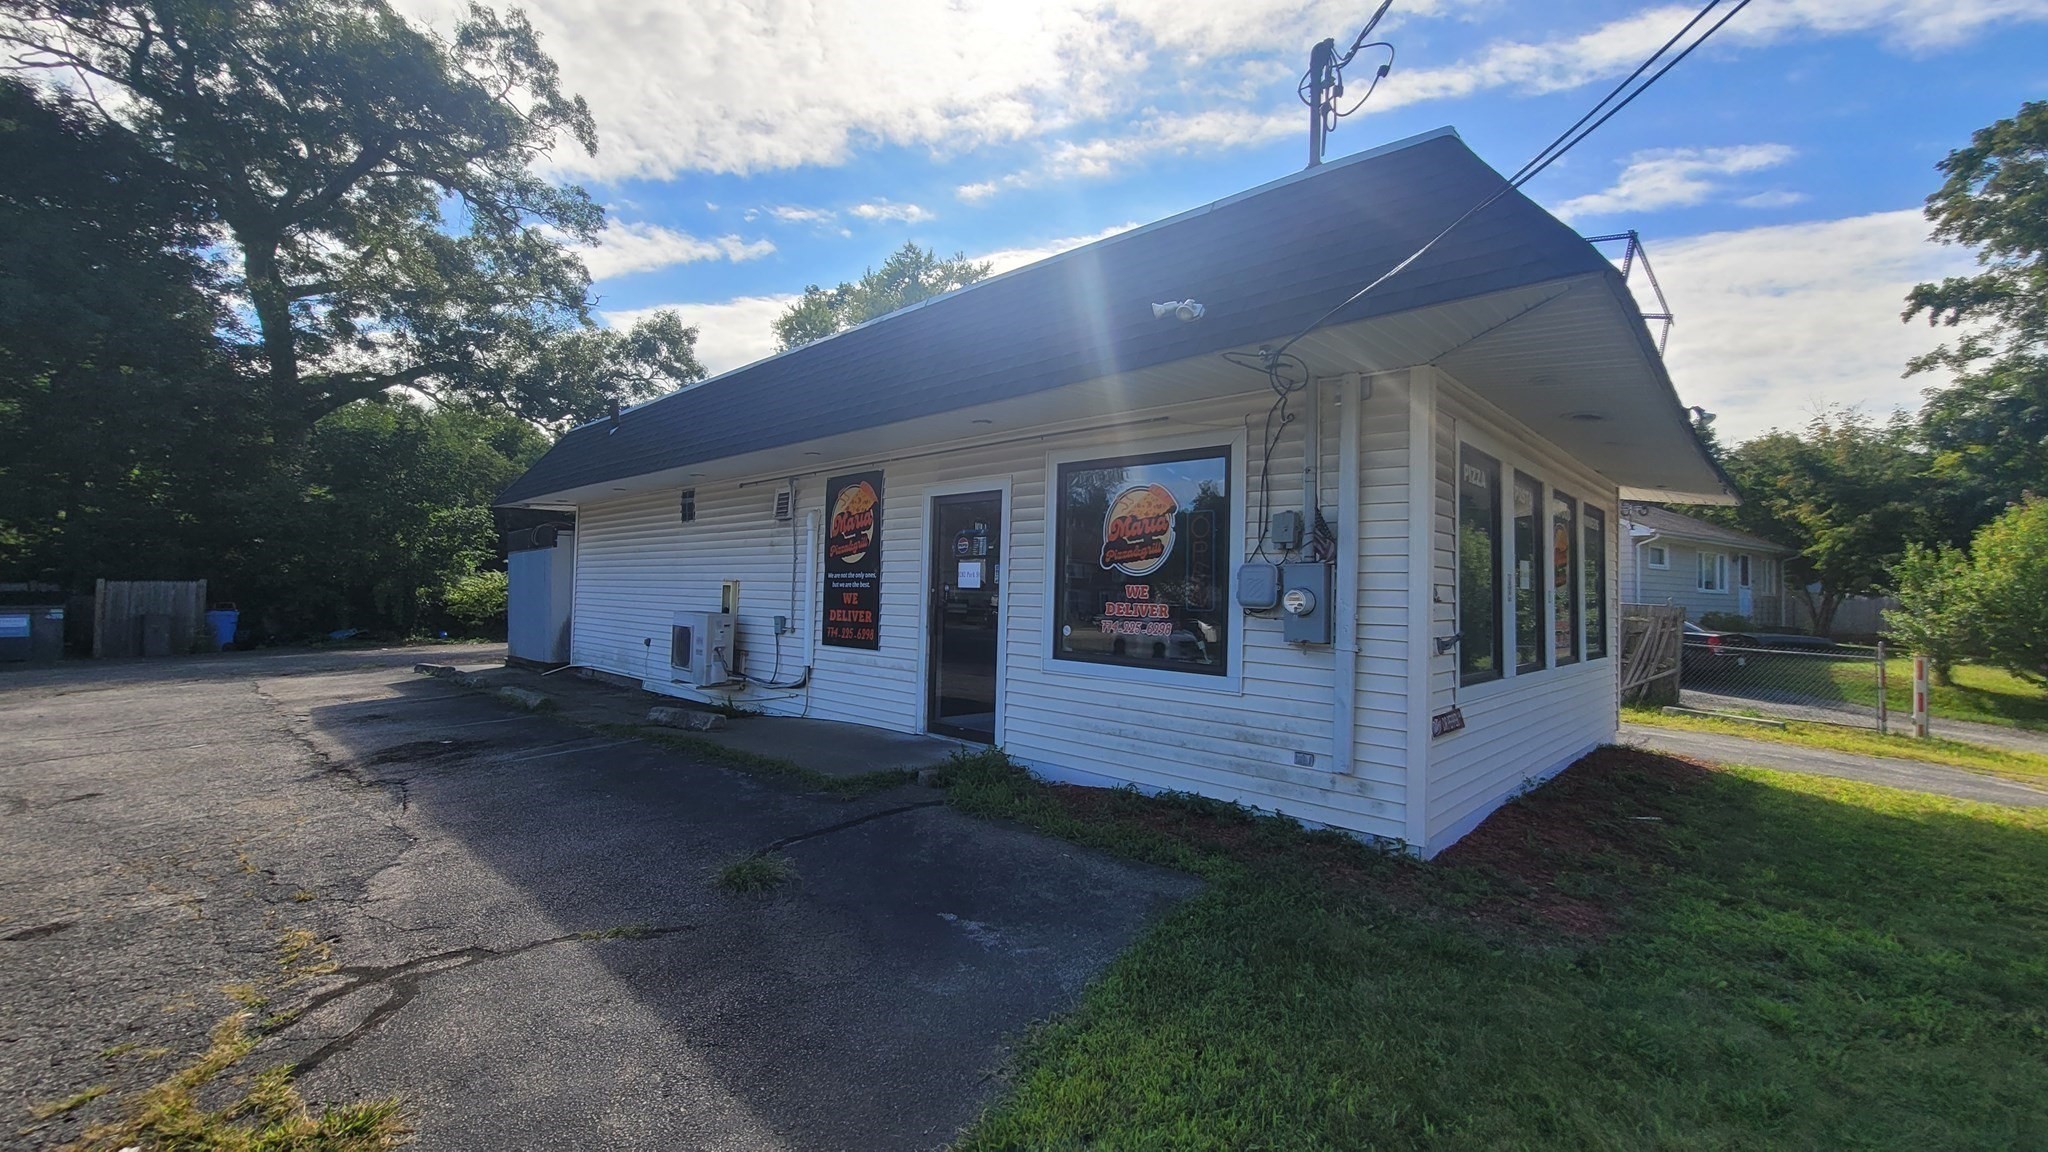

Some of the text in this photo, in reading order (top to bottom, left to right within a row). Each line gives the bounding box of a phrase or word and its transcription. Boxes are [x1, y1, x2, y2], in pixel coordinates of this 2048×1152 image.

[1464, 463, 1486, 489] PIZZA
[832, 511, 873, 537] Maria
[1108, 515, 1169, 541] Maria
[843, 592, 858, 604] WE
[1125, 585, 1149, 599] WE
[829, 609, 872, 623] DELIVER
[1105, 602, 1169, 618] DELIVER
